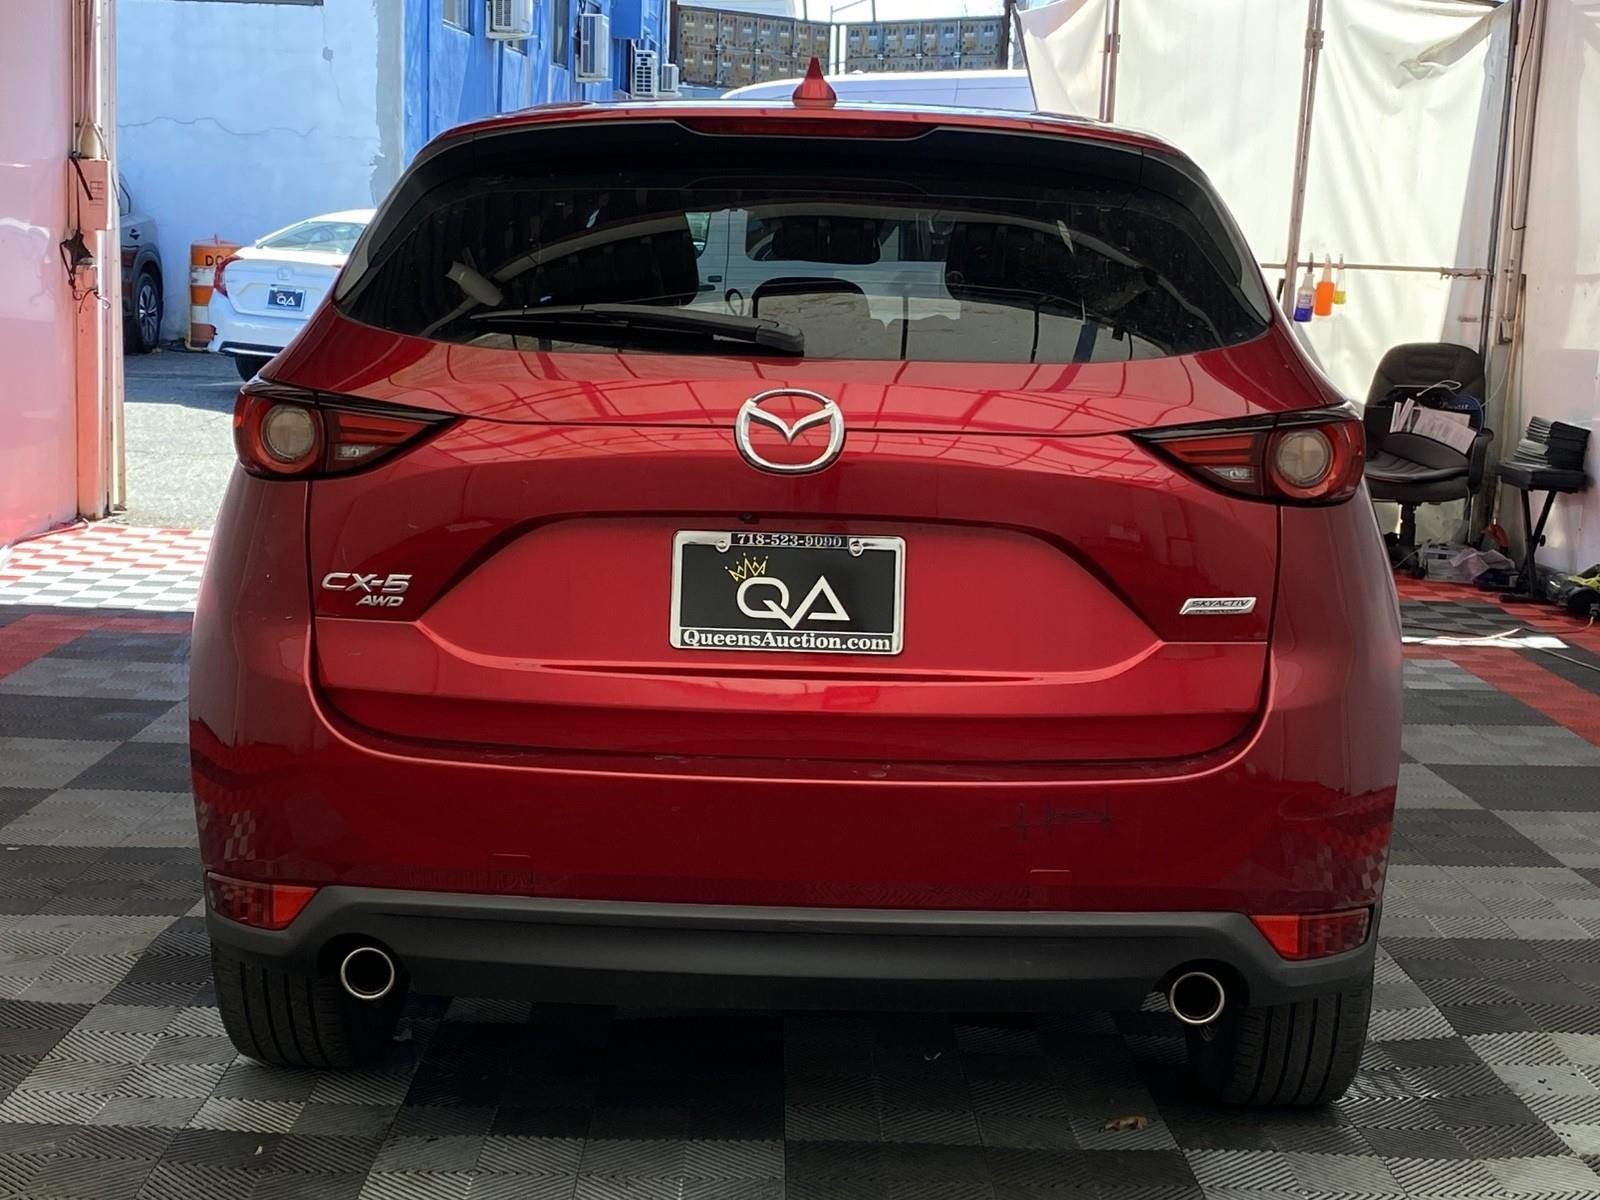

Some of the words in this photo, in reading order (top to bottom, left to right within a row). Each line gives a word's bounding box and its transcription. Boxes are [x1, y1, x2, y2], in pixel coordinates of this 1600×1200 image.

[277, 295, 295, 306] QA
[737, 534, 842, 548] 718-523-9090
[321, 572, 413, 593] CX-5
[355, 595, 404, 607] AWD
[737, 575, 850, 629] QA
[683, 630, 890, 650] QueensAuction.com
